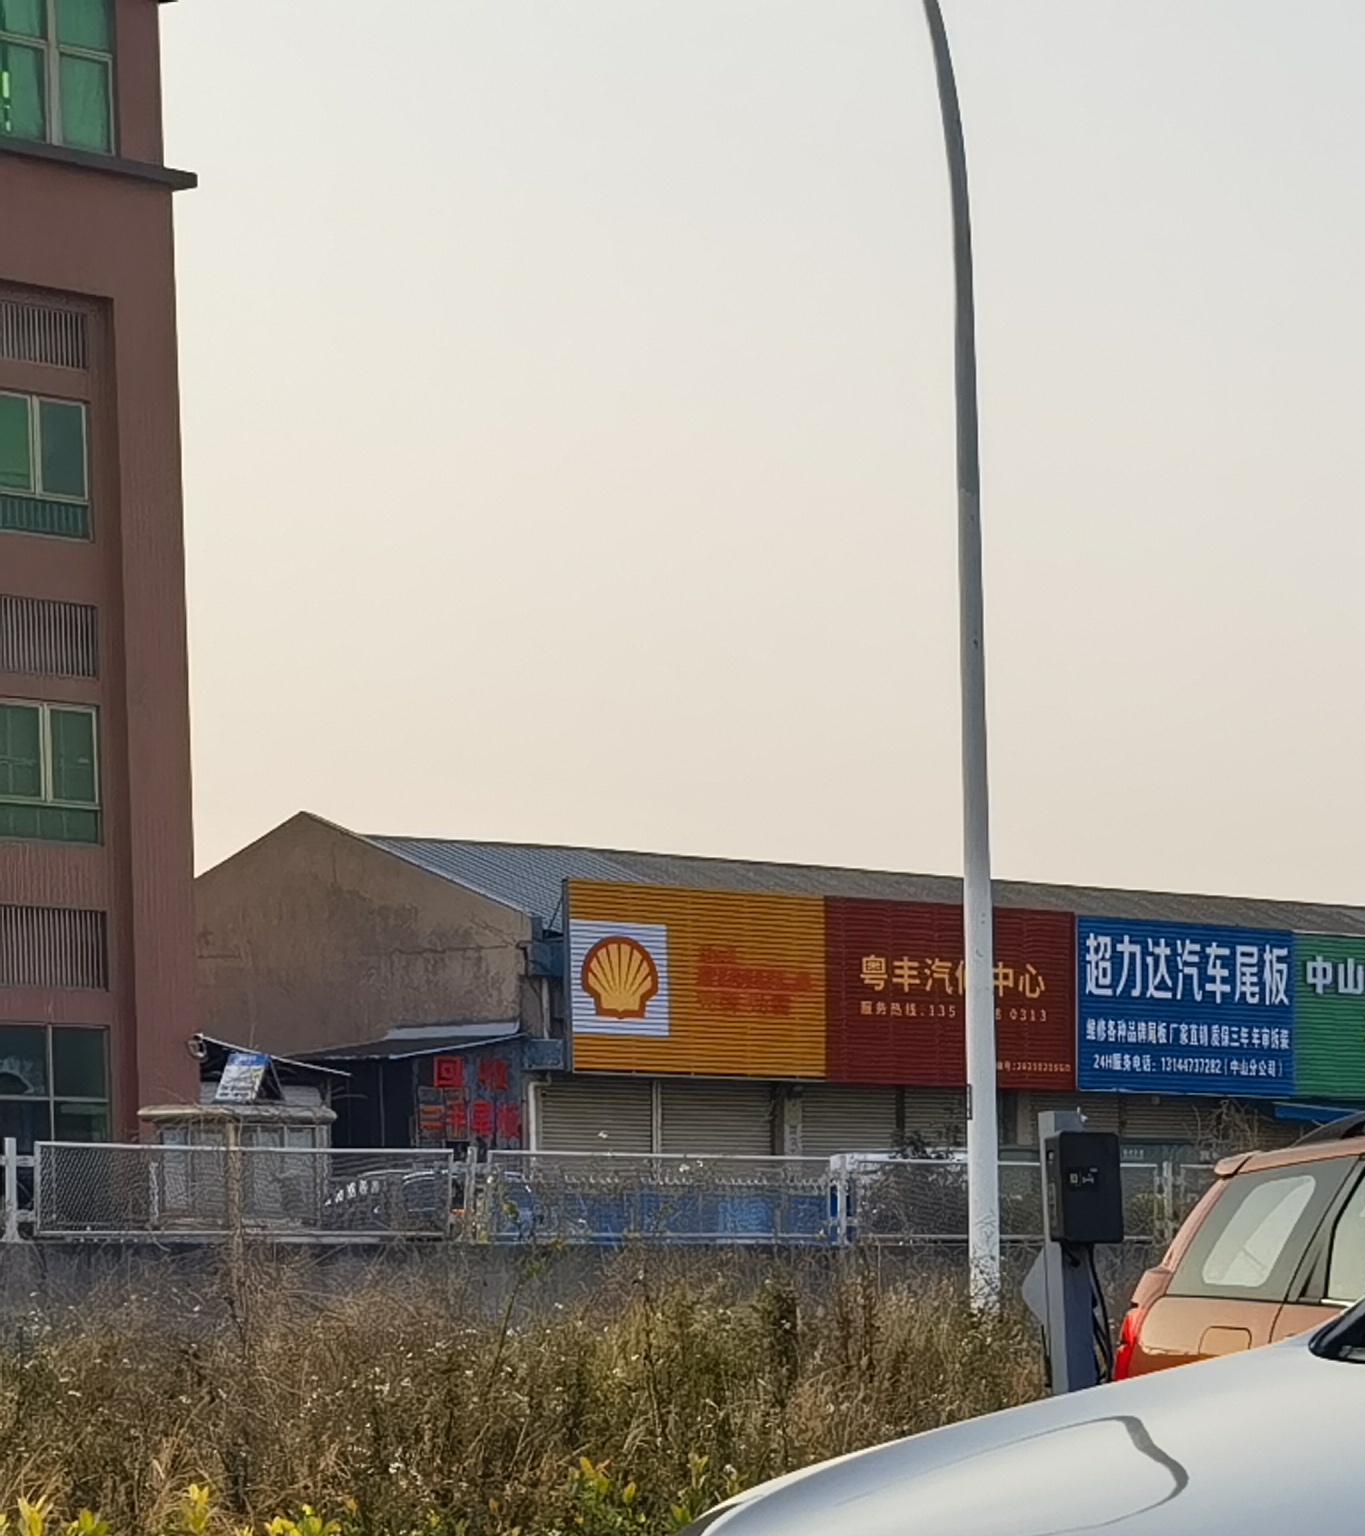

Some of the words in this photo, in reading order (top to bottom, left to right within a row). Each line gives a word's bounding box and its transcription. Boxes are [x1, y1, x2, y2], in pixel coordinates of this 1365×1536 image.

[1086, 933, 1290, 1005] 超力达汽车尾板
